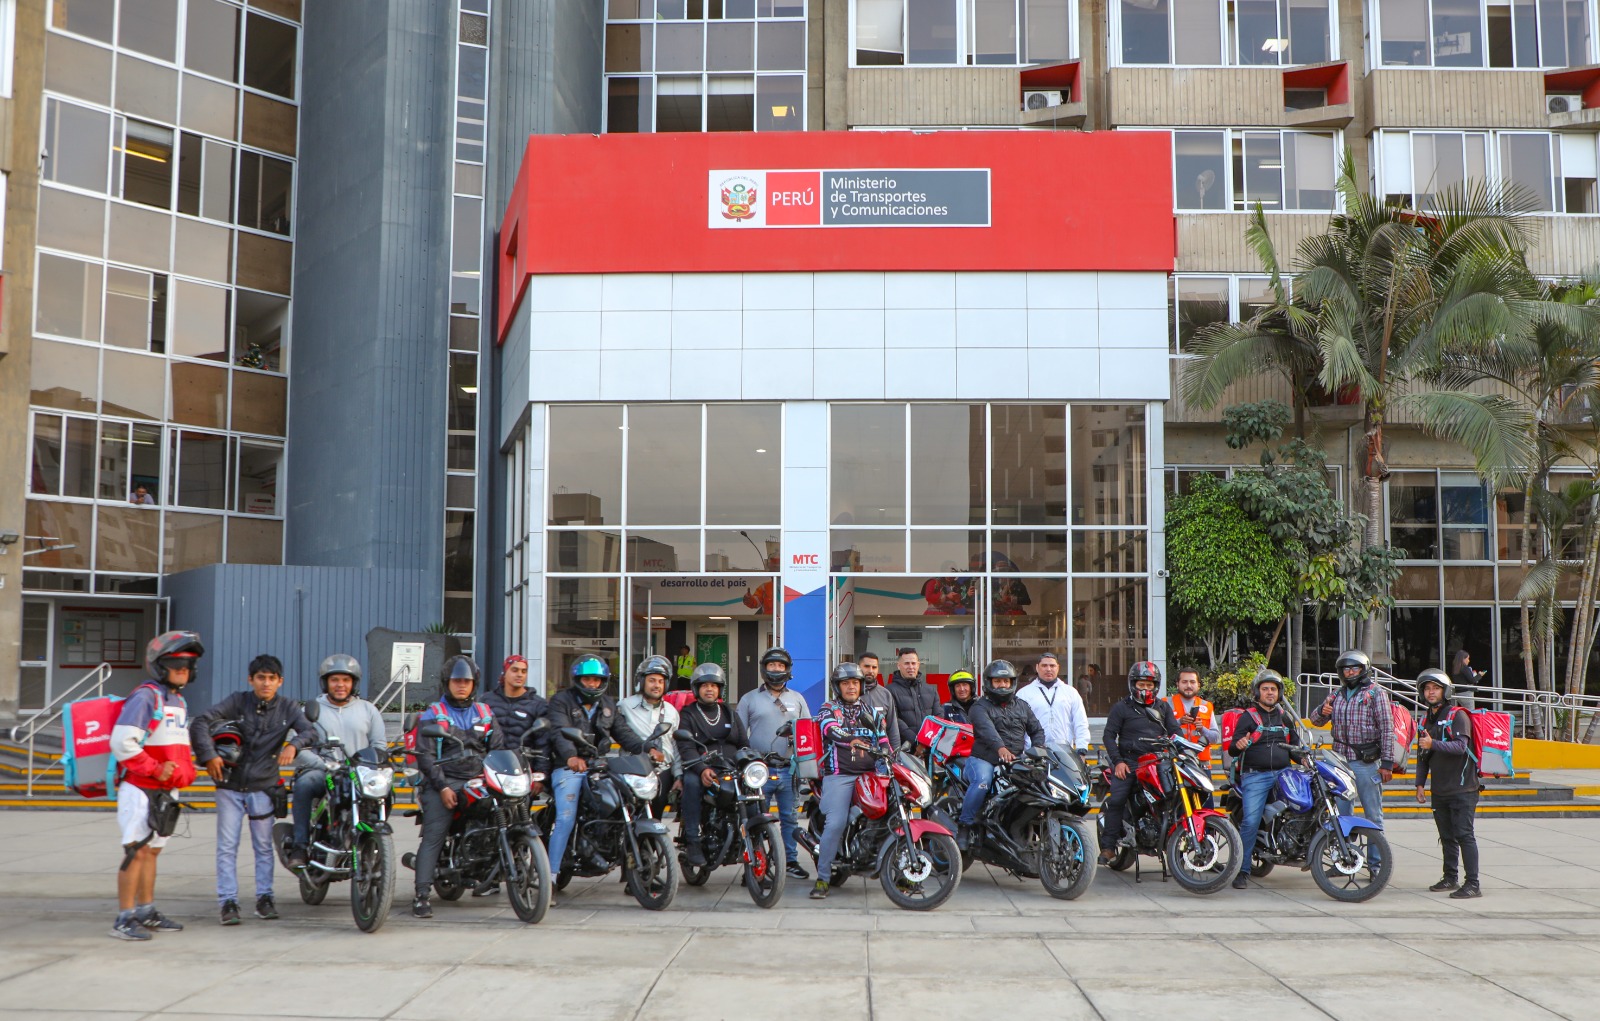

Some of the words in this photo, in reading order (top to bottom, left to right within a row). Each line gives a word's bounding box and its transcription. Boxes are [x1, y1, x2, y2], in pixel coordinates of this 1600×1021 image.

[830, 177, 897, 189] Ministerio
[772, 187, 814, 206] PERÚ
[830, 190, 847, 203] de
[850, 190, 927, 205] Transportes
[830, 206, 838, 219] y
[841, 203, 948, 216] Comunicaciones
[792, 554, 819, 565] MTC
[660, 578, 709, 588] desarrollo
[710, 578, 725, 588] del
[727, 577, 747, 589] país
[1006, 639, 1022, 647] MTC
[1037, 639, 1053, 647] MTC
